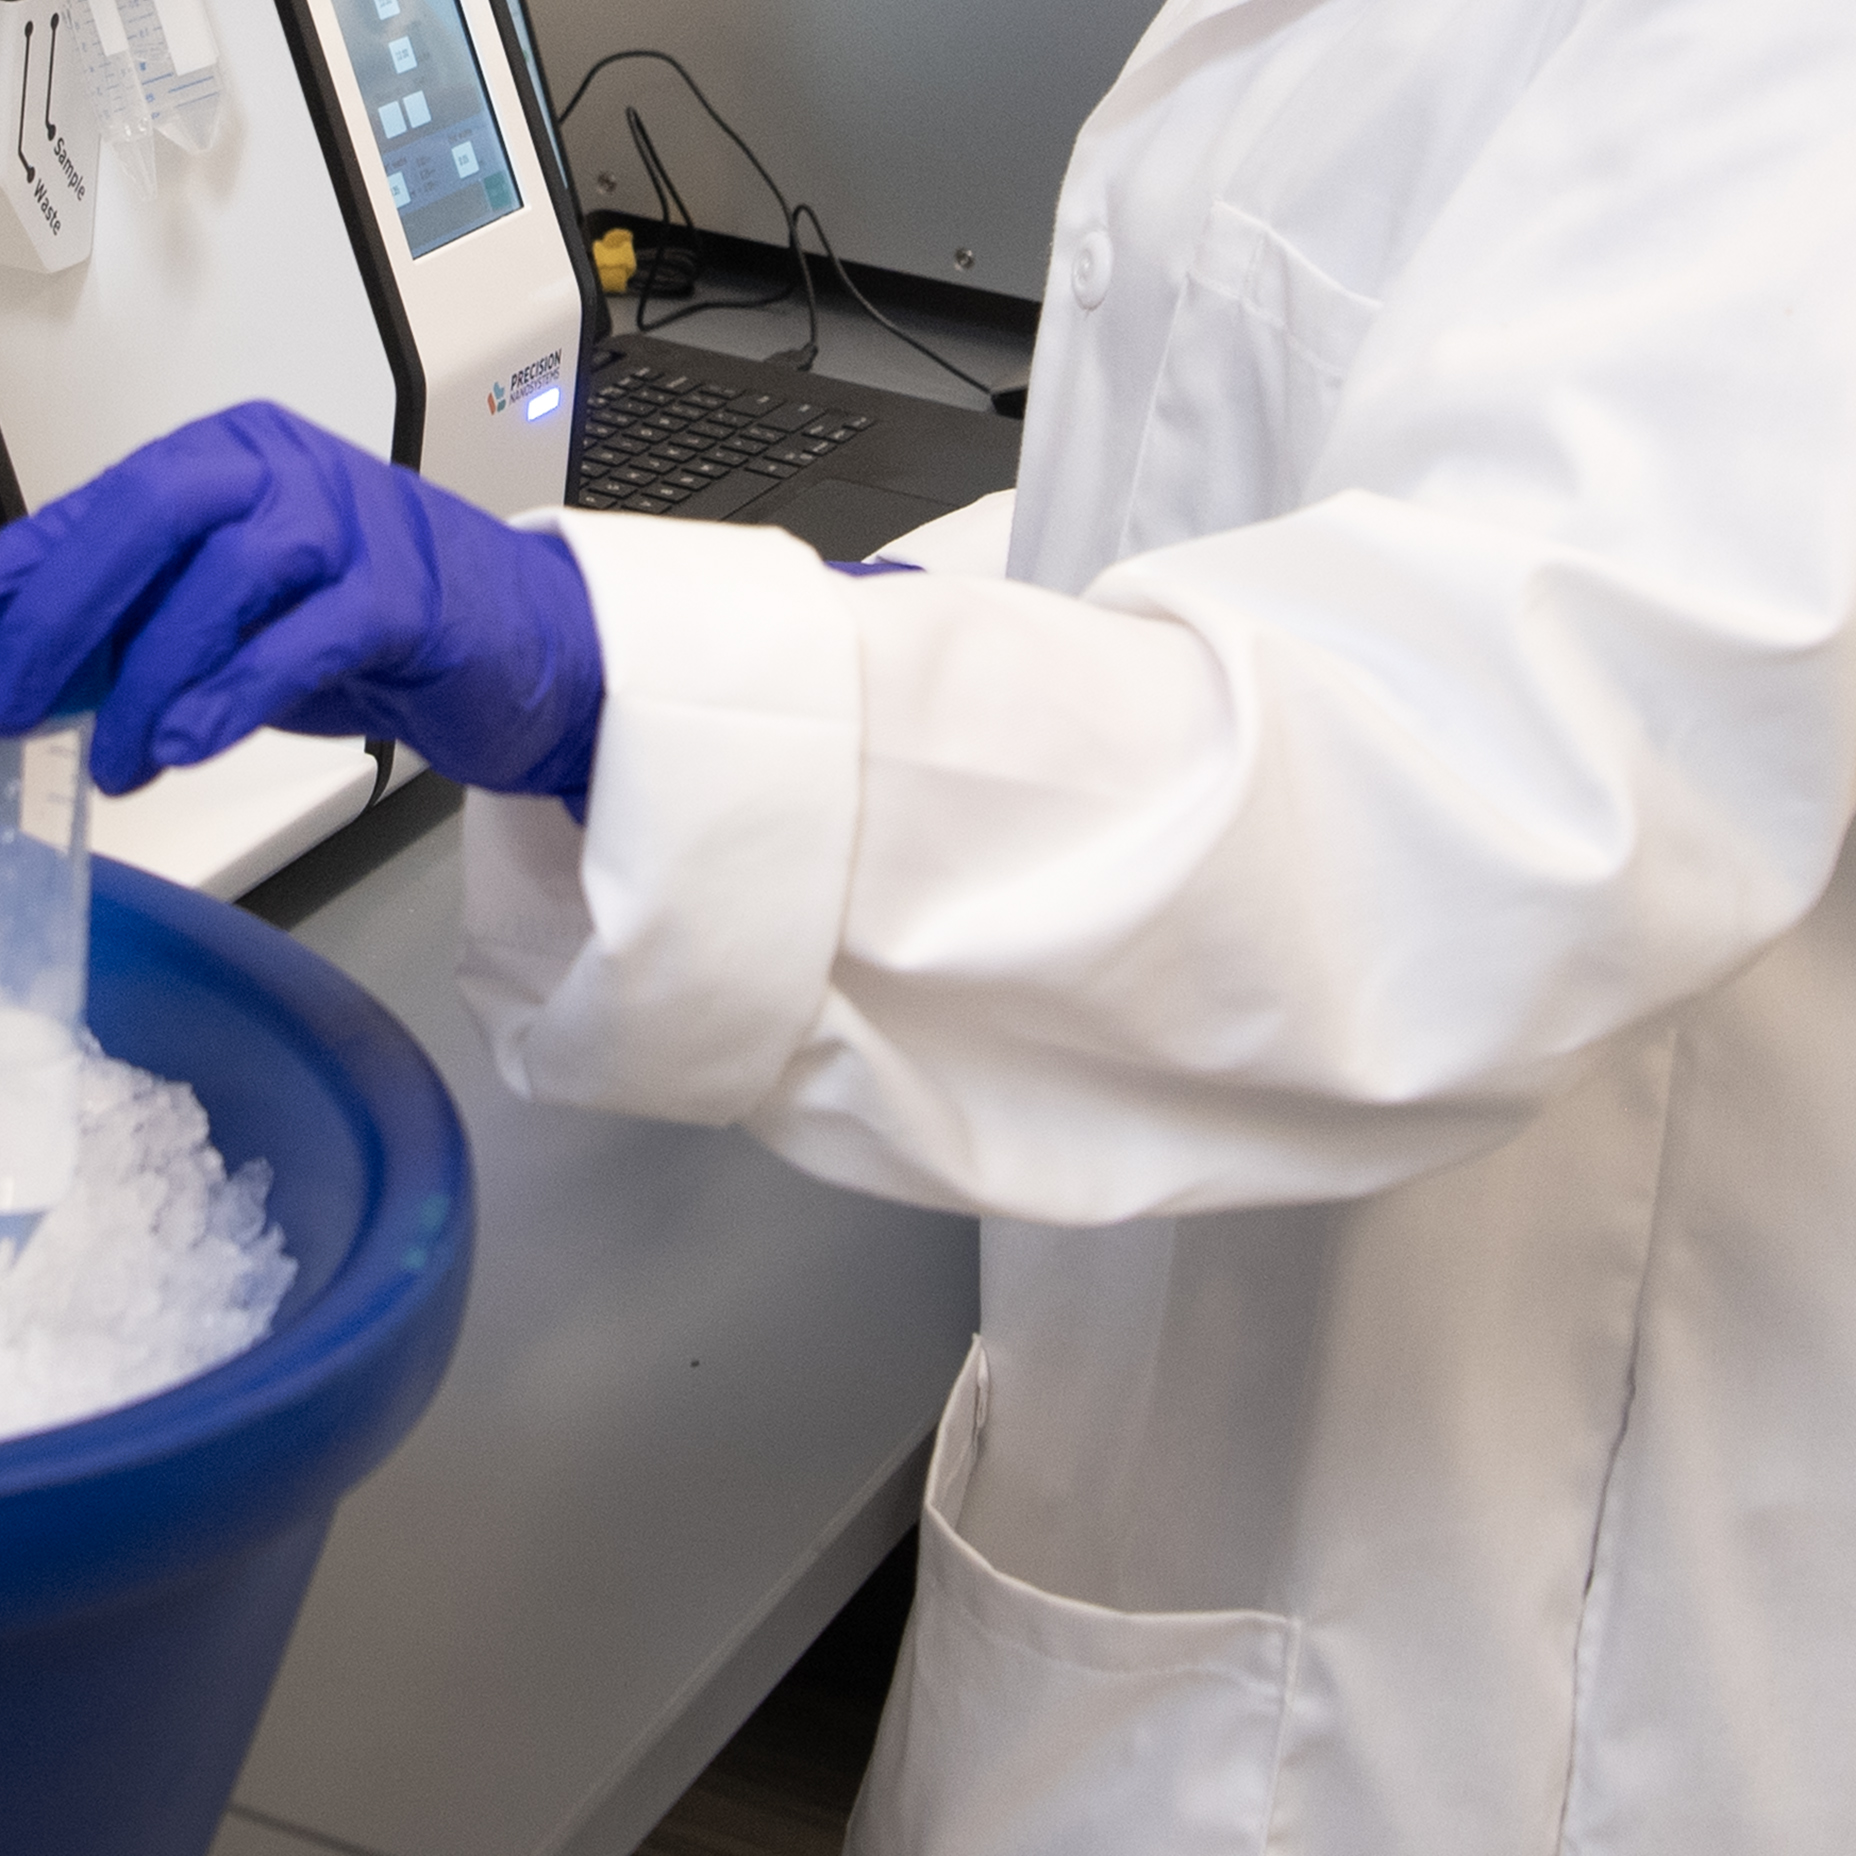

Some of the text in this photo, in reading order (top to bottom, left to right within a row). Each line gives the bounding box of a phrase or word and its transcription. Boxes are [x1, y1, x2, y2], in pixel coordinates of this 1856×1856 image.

[53, 137, 88, 202] Sample
[33, 177, 62, 237] Waste
[508, 366, 561, 405] NANOSYSTEMS
[509, 347, 563, 392] PRECISION
